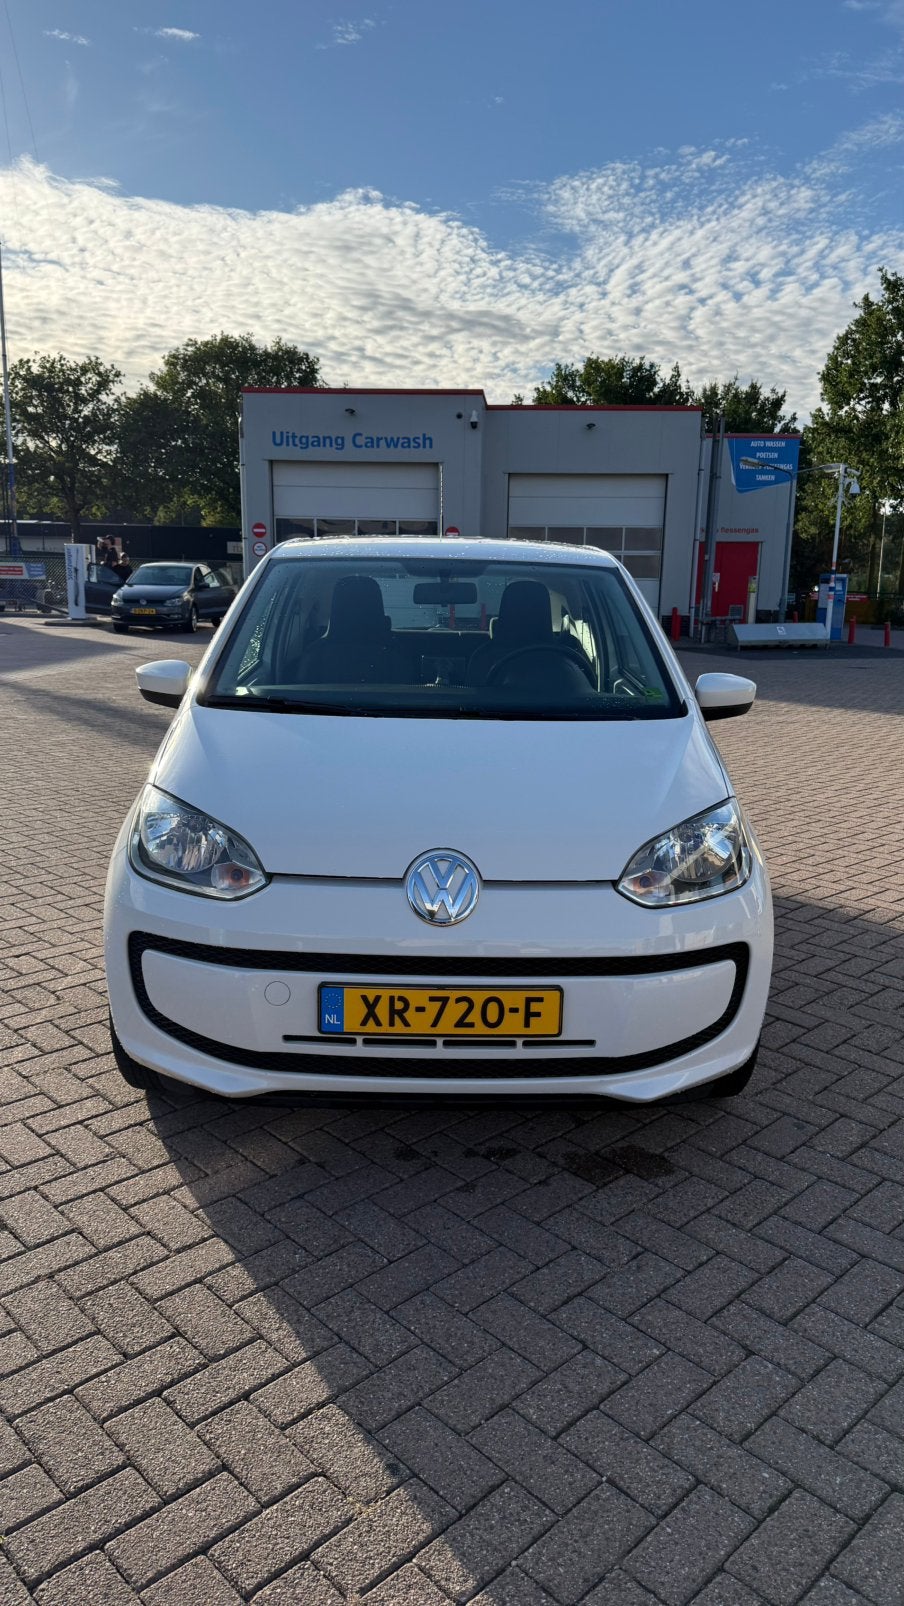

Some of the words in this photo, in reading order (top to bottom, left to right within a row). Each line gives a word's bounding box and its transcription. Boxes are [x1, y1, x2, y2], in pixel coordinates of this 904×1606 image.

[272, 430, 345, 450] Uitgang
[351, 432, 433, 449] Carwash
[325, 1014, 341, 1024] NL
[359, 994, 545, 1029] XR-720-F
